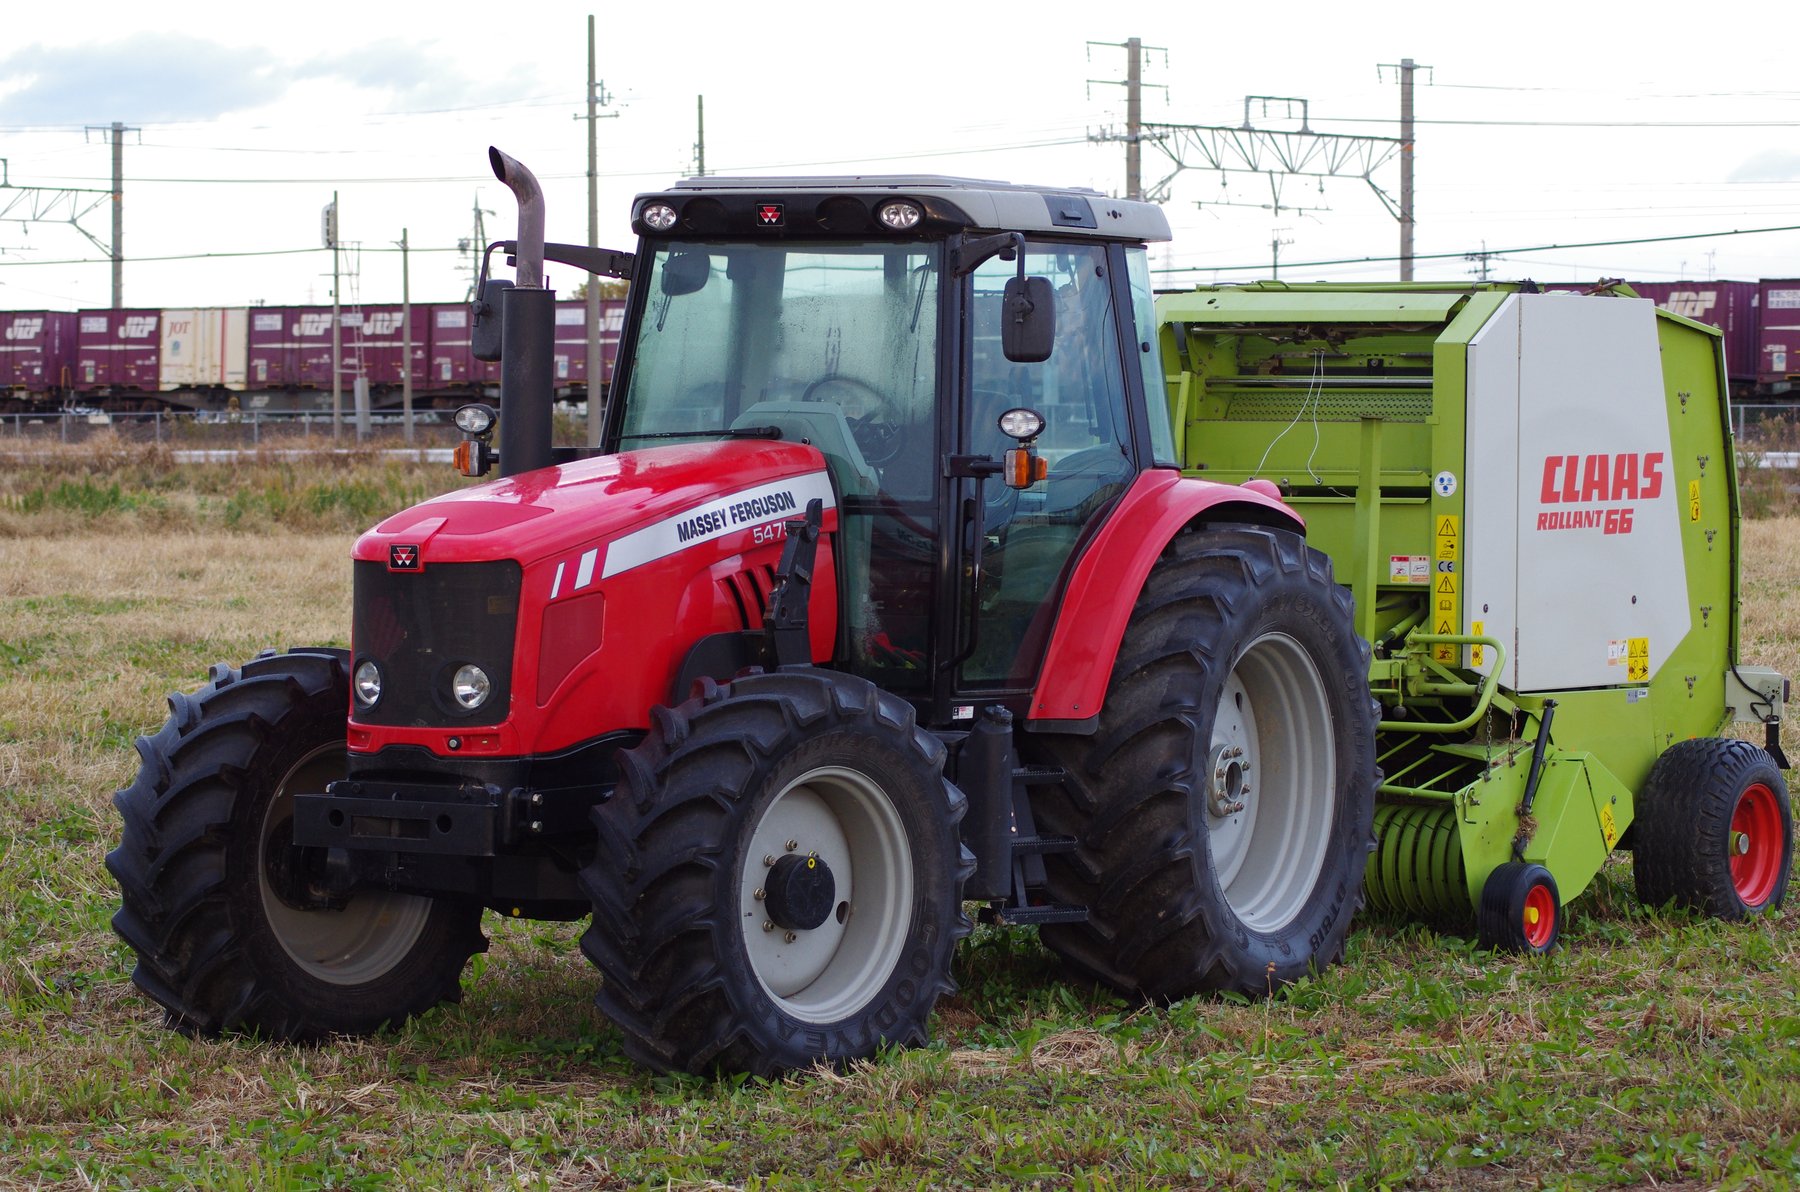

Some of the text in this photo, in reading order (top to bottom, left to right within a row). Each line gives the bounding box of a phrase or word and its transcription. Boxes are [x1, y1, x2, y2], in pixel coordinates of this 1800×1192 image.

[6, 318, 43, 340] JRF
[118, 316, 158, 338] JRF
[167, 321, 191, 338] JOT
[292, 313, 333, 336] JRF
[1540, 452, 1664, 504] CLAAS
[677, 491, 796, 542] MASSEY FERGUSON
[1536, 508, 1634, 535] ROLLANT 66
[1309, 881, 1347, 953] DT818
